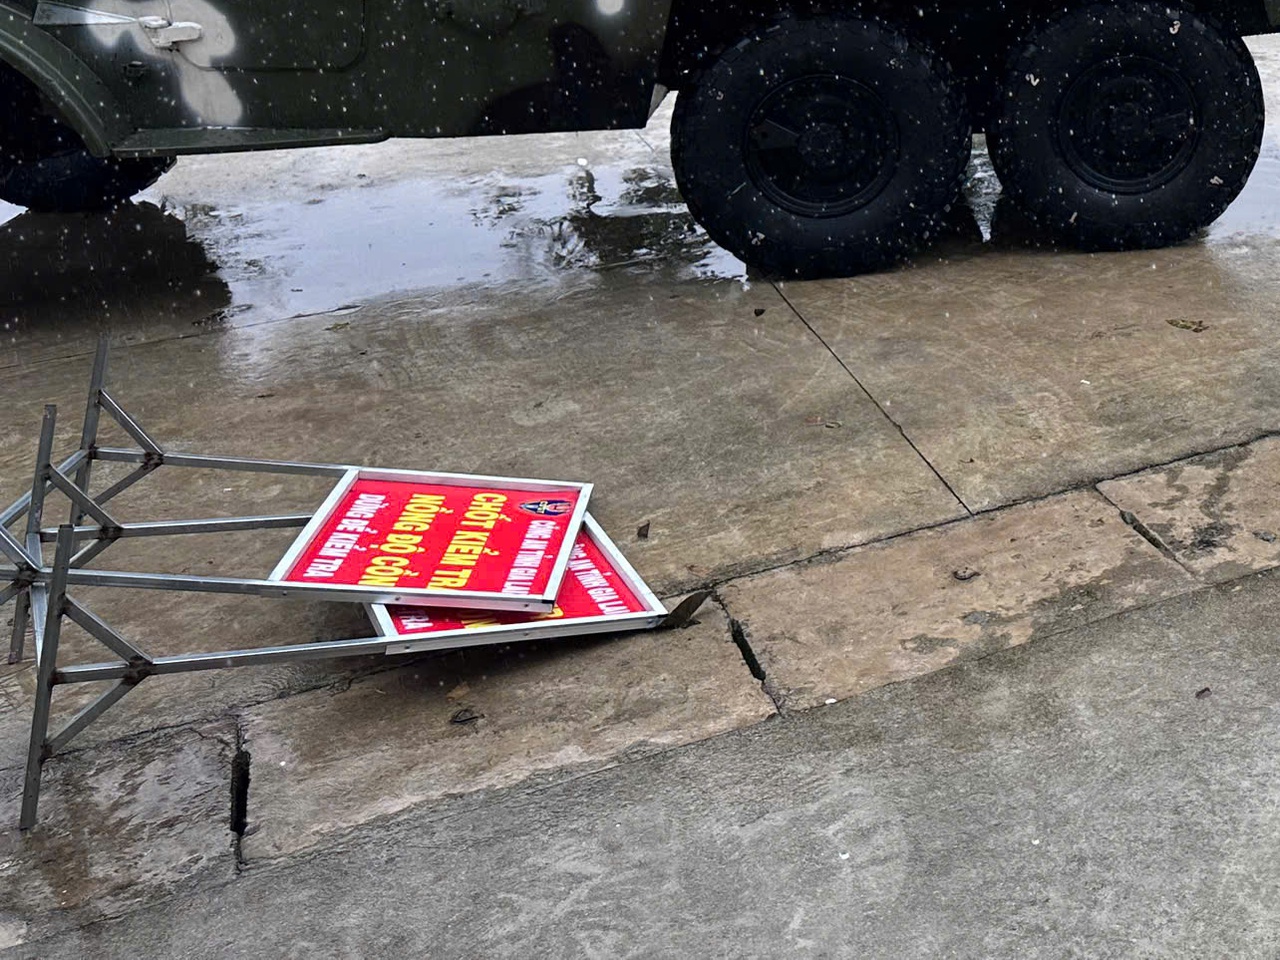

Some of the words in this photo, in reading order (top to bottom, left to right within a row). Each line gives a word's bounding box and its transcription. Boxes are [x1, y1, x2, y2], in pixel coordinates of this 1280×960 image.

[345, 493, 389, 519] DỪNG
[392, 493, 454, 532] NỒNG
[460, 492, 512, 529] CHỐT
[336, 518, 378, 534] ĐỂ
[525, 520, 560, 539] CÔNG
[318, 531, 367, 558] KIỂM
[369, 533, 426, 554] ĐỘ
[439, 530, 500, 566] KIỂM
[520, 539, 549, 550] AN
[303, 558, 344, 577] TRA
[512, 550, 553, 568] TỈNH
[357, 555, 420, 587] CỒN
[506, 567, 538, 581] GIA
[574, 568, 613, 588] TỈNH
[587, 587, 620, 603] GIA
